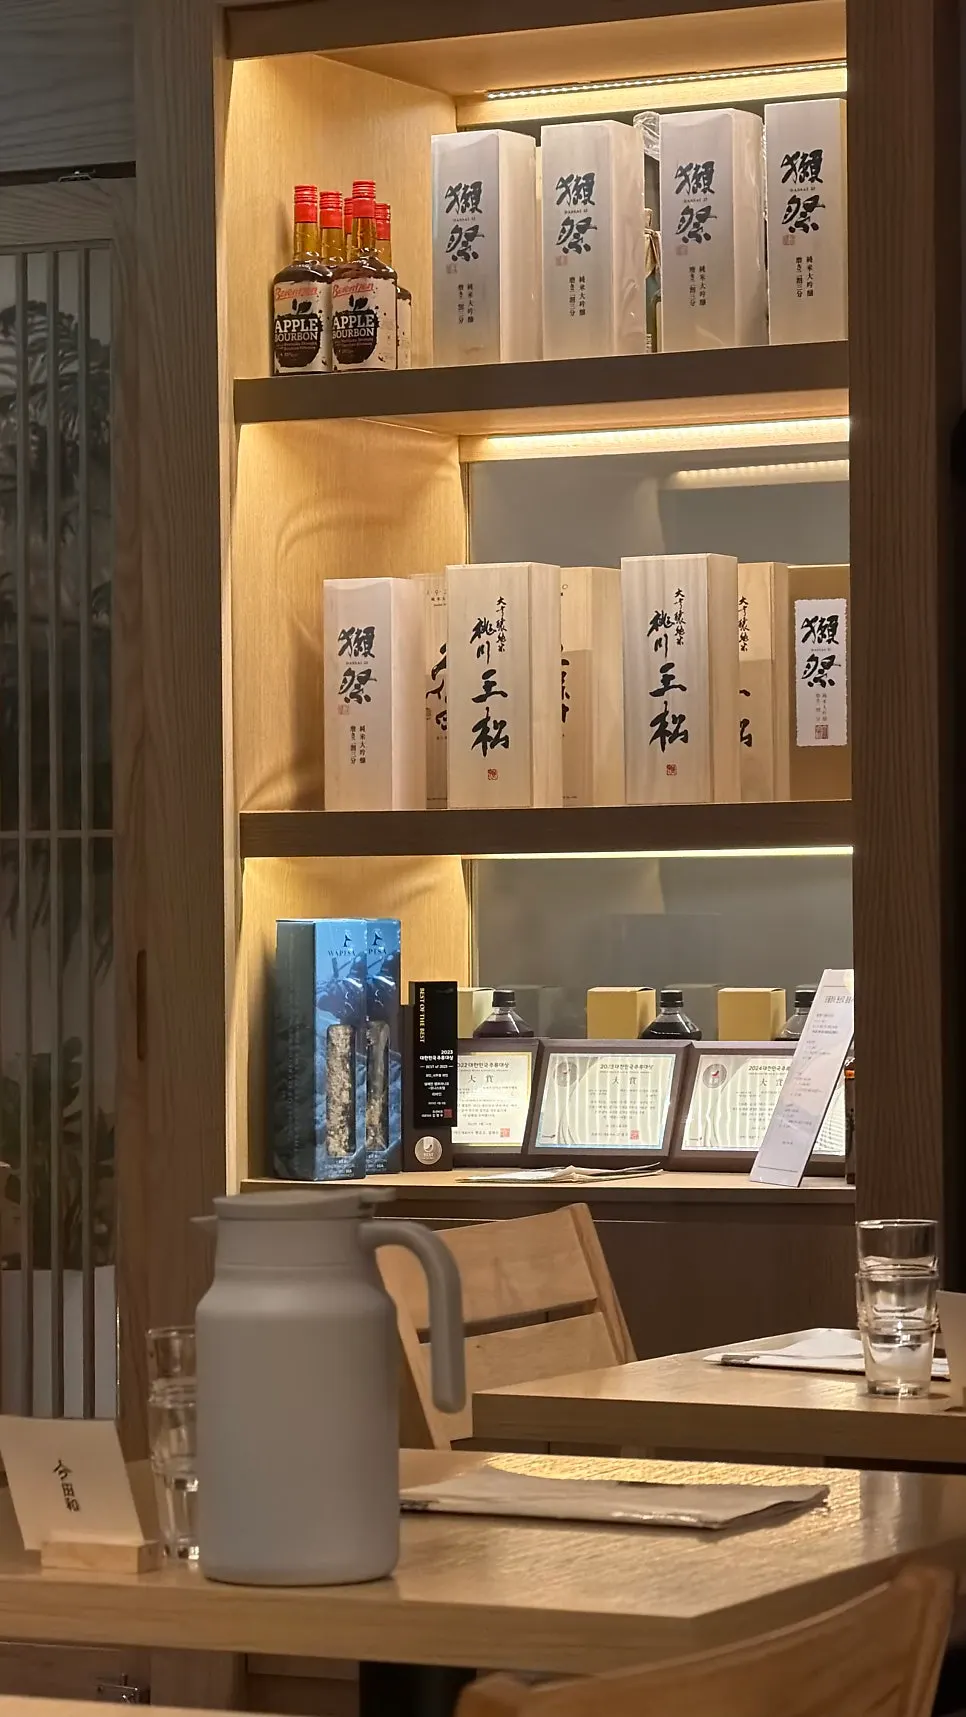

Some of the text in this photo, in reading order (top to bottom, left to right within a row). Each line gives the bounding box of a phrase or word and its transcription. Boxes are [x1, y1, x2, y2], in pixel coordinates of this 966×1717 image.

[275, 319, 318, 333] APPLE
[333, 314, 375, 330] APPLE
[275, 332, 318, 342] BOURBON
[332, 327, 375, 339] BOURBON
